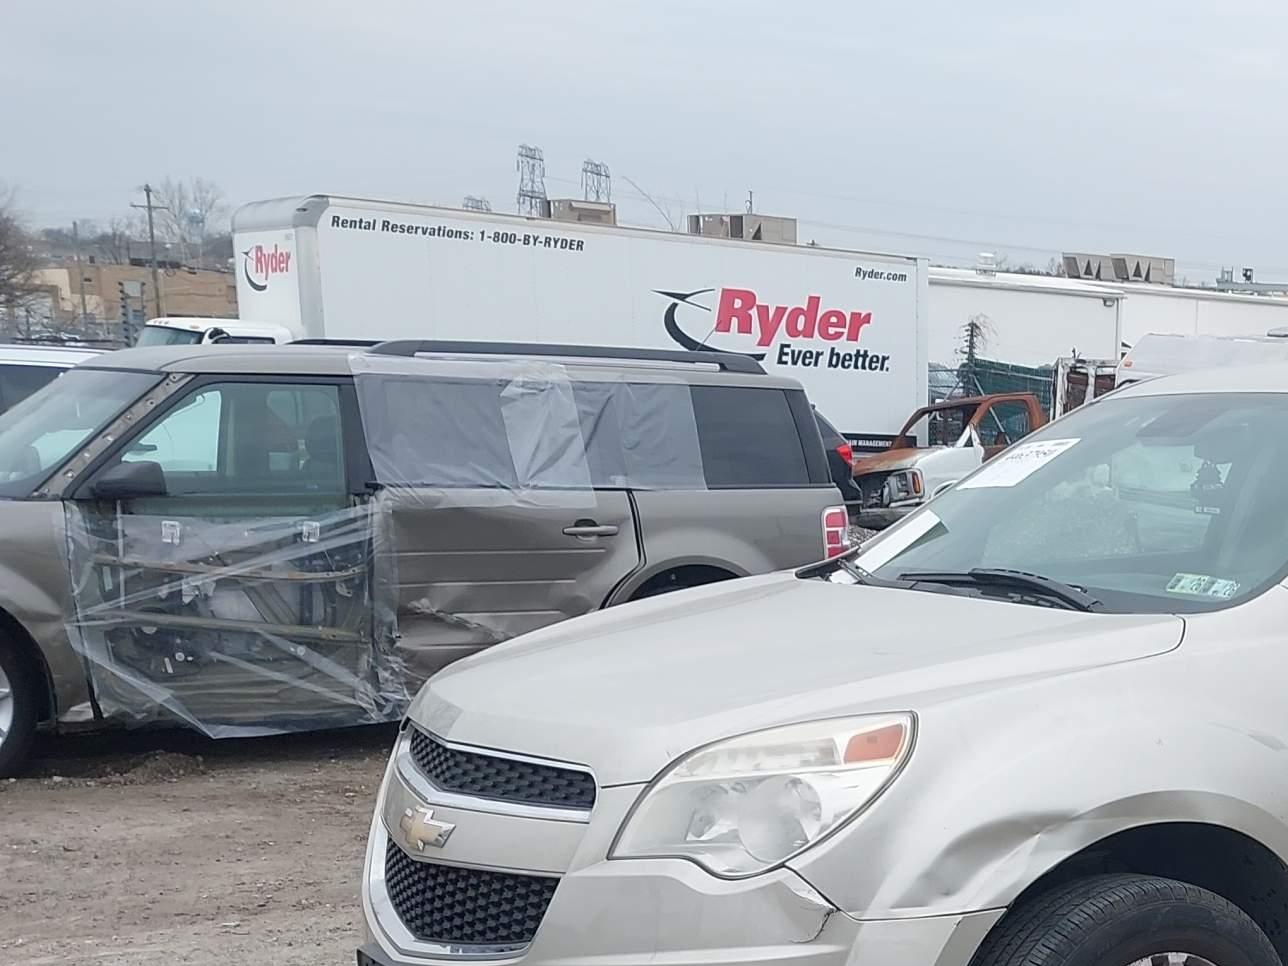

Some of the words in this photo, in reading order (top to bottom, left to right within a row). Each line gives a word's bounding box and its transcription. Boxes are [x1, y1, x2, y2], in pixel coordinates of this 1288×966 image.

[331, 215, 376, 231] Rental
[381, 219, 474, 241] Reservations:
[479, 230, 585, 251] 1-800-BY-RYDER
[255, 244, 291, 281] Ryder
[855, 267, 908, 282] Ryder.com
[714, 287, 873, 347] Ryder
[776, 343, 825, 368] Ever
[827, 346, 891, 372] better.
